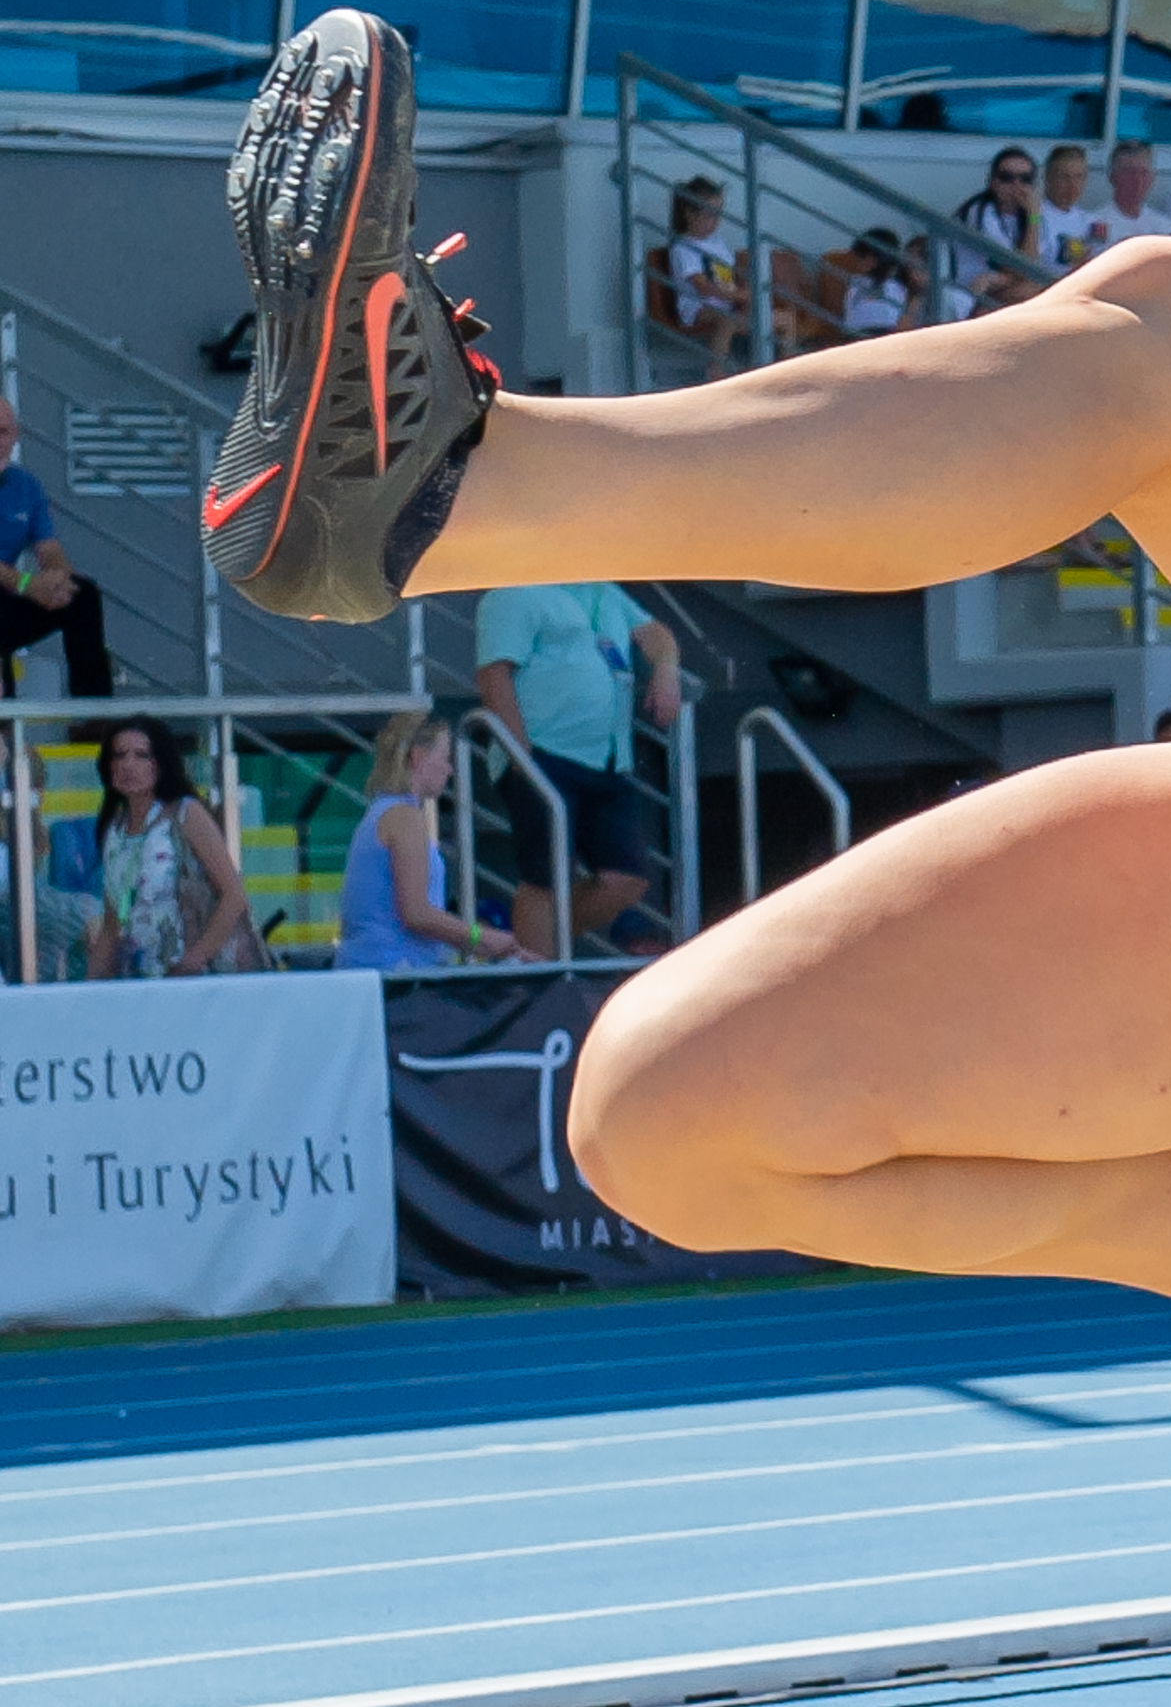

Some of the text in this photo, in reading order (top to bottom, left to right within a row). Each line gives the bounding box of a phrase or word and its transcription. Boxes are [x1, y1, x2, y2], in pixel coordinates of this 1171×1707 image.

[47, 1154, 56, 1215] i
[84, 1134, 355, 1223] Turystyki
[539, 1217, 655, 1251] MIAS
